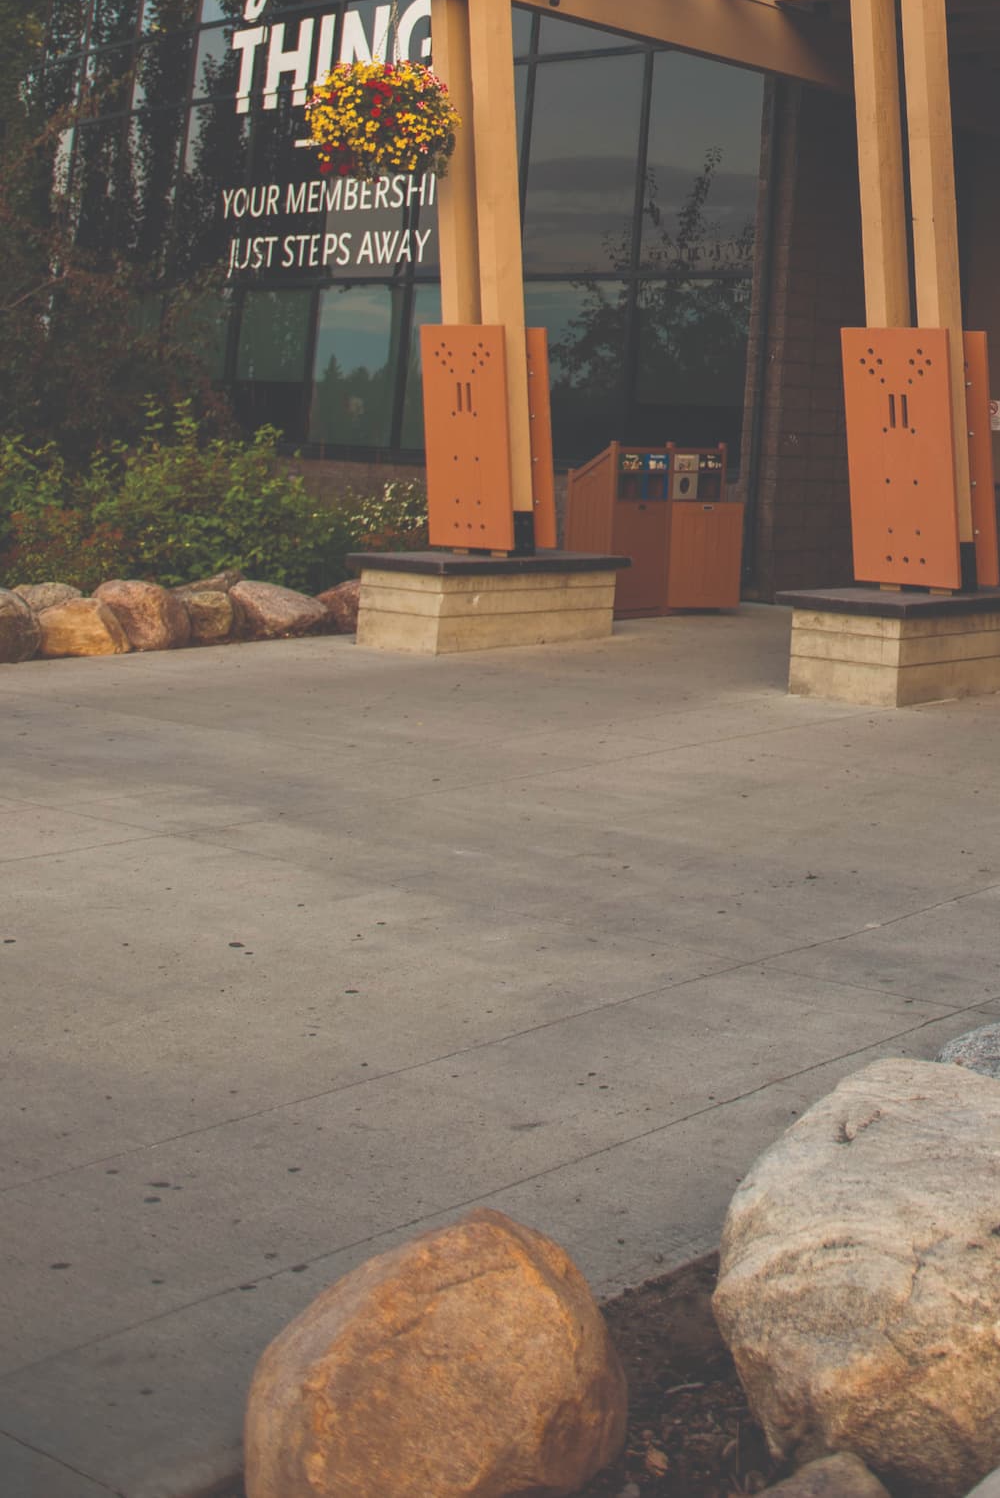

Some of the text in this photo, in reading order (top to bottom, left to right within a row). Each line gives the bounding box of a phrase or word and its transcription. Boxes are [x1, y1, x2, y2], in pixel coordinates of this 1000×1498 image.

[222, 173, 435, 219] YOUR MEMBERSHI
[227, 228, 432, 279] JUST STEPS AWAY
